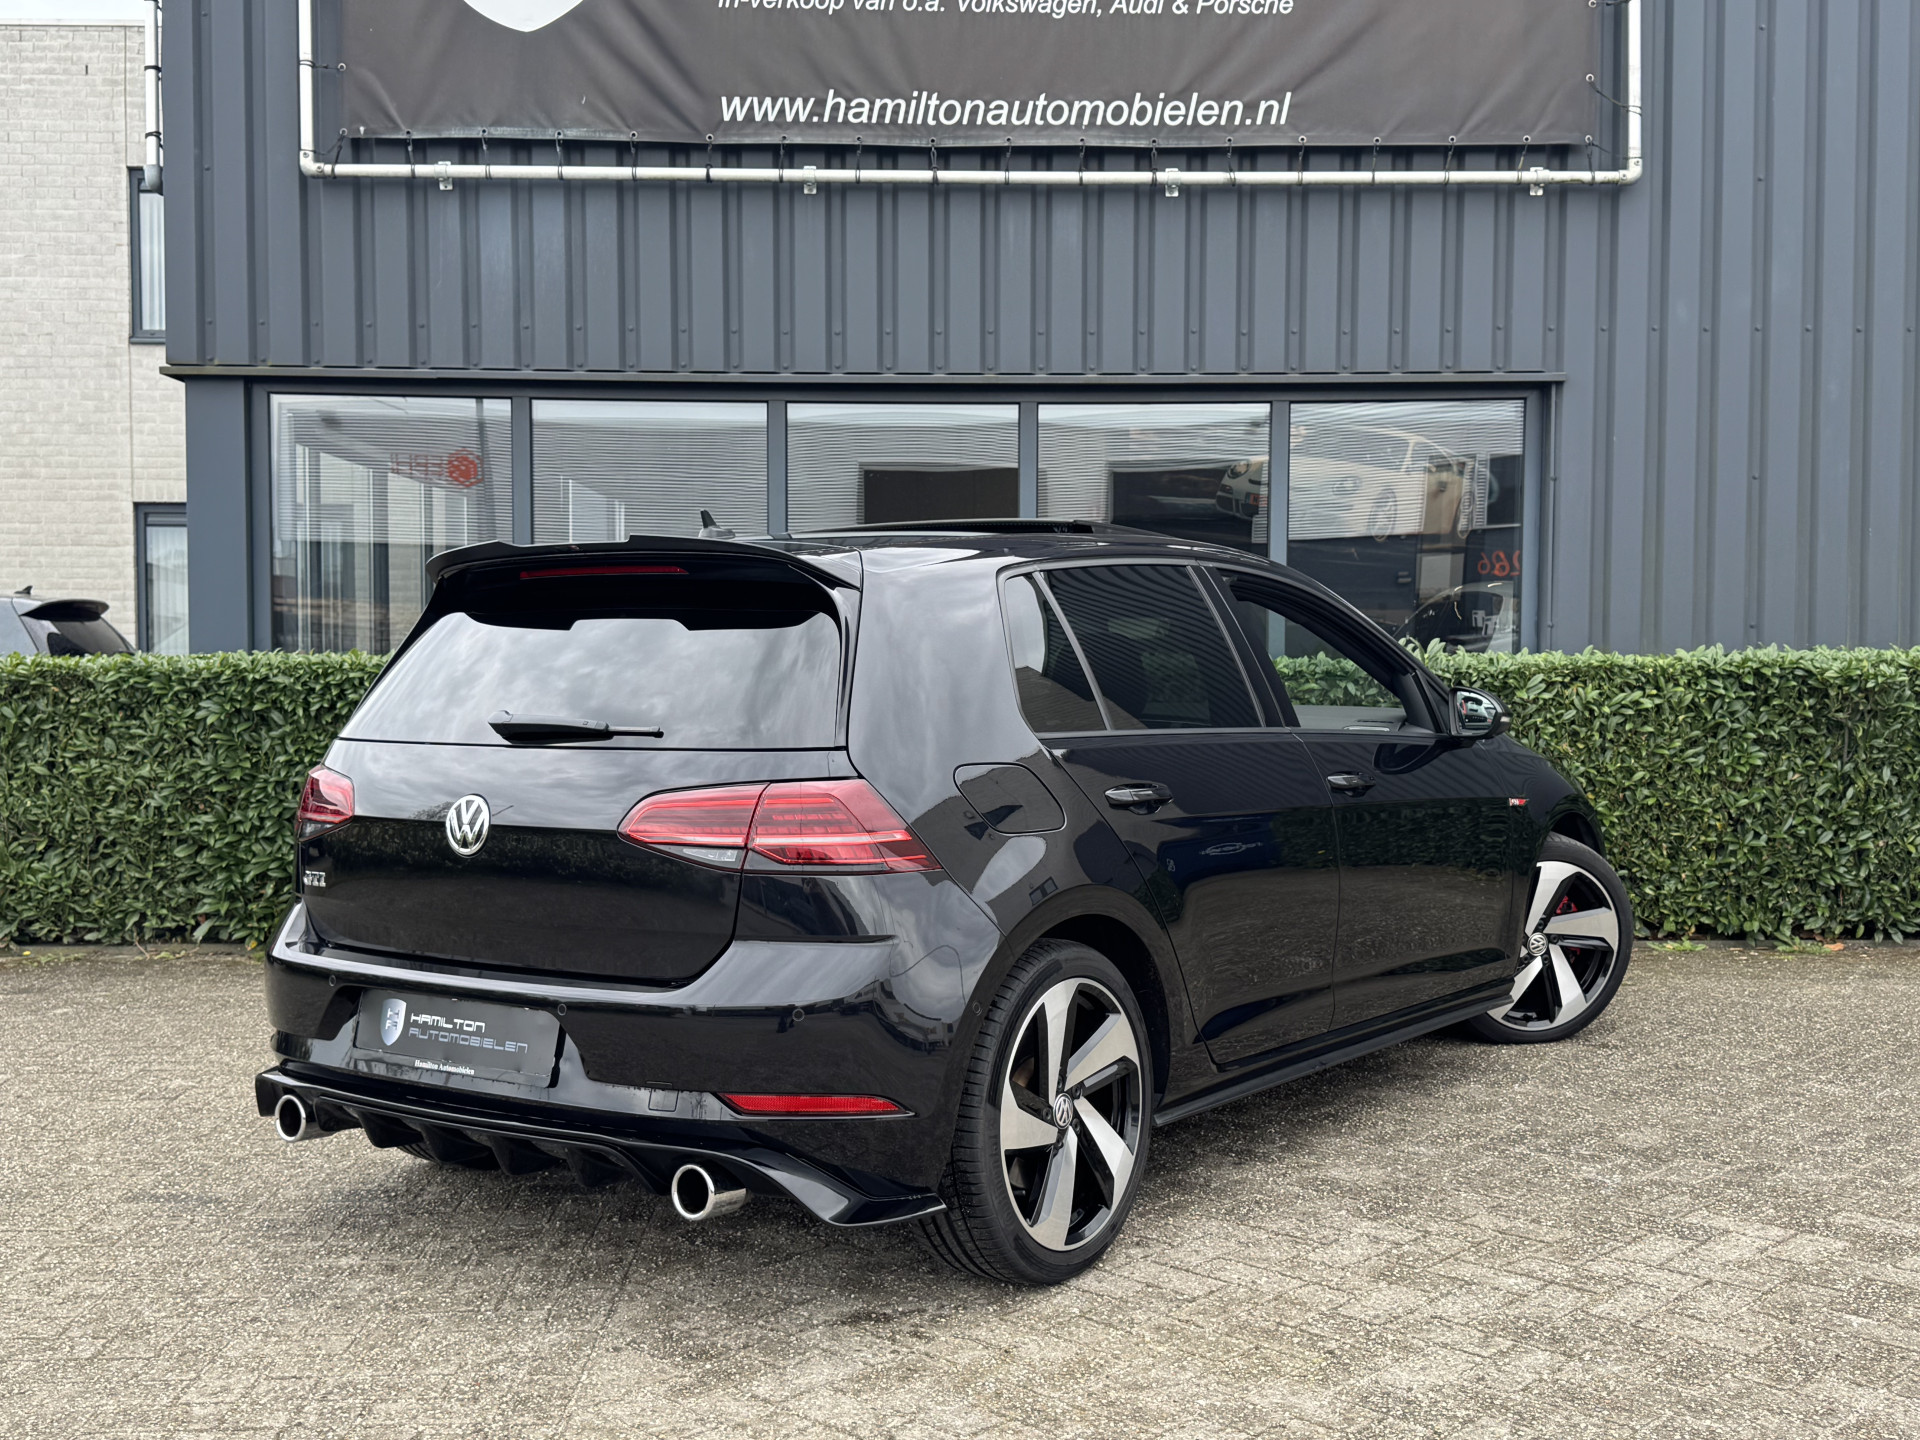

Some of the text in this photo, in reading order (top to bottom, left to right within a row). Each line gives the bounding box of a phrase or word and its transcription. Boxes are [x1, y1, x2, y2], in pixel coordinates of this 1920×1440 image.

[853, 0, 896, 11] van
[902, 0, 946, 12] o.a.
[957, 0, 1102, 20] Volkswagen,
[1108, 0, 1165, 15] Audi
[1171, 0, 1189, 15] &
[1195, 0, 1295, 15] Porsche
[721, 89, 1292, 127] www.hamiltonautomobielen.nl
[410, 1012, 486, 1034] HAMILTON
[408, 1027, 528, 1053] AUTOMOBIELEN
[414, 1059, 475, 1075] Hamilton Automobielen
